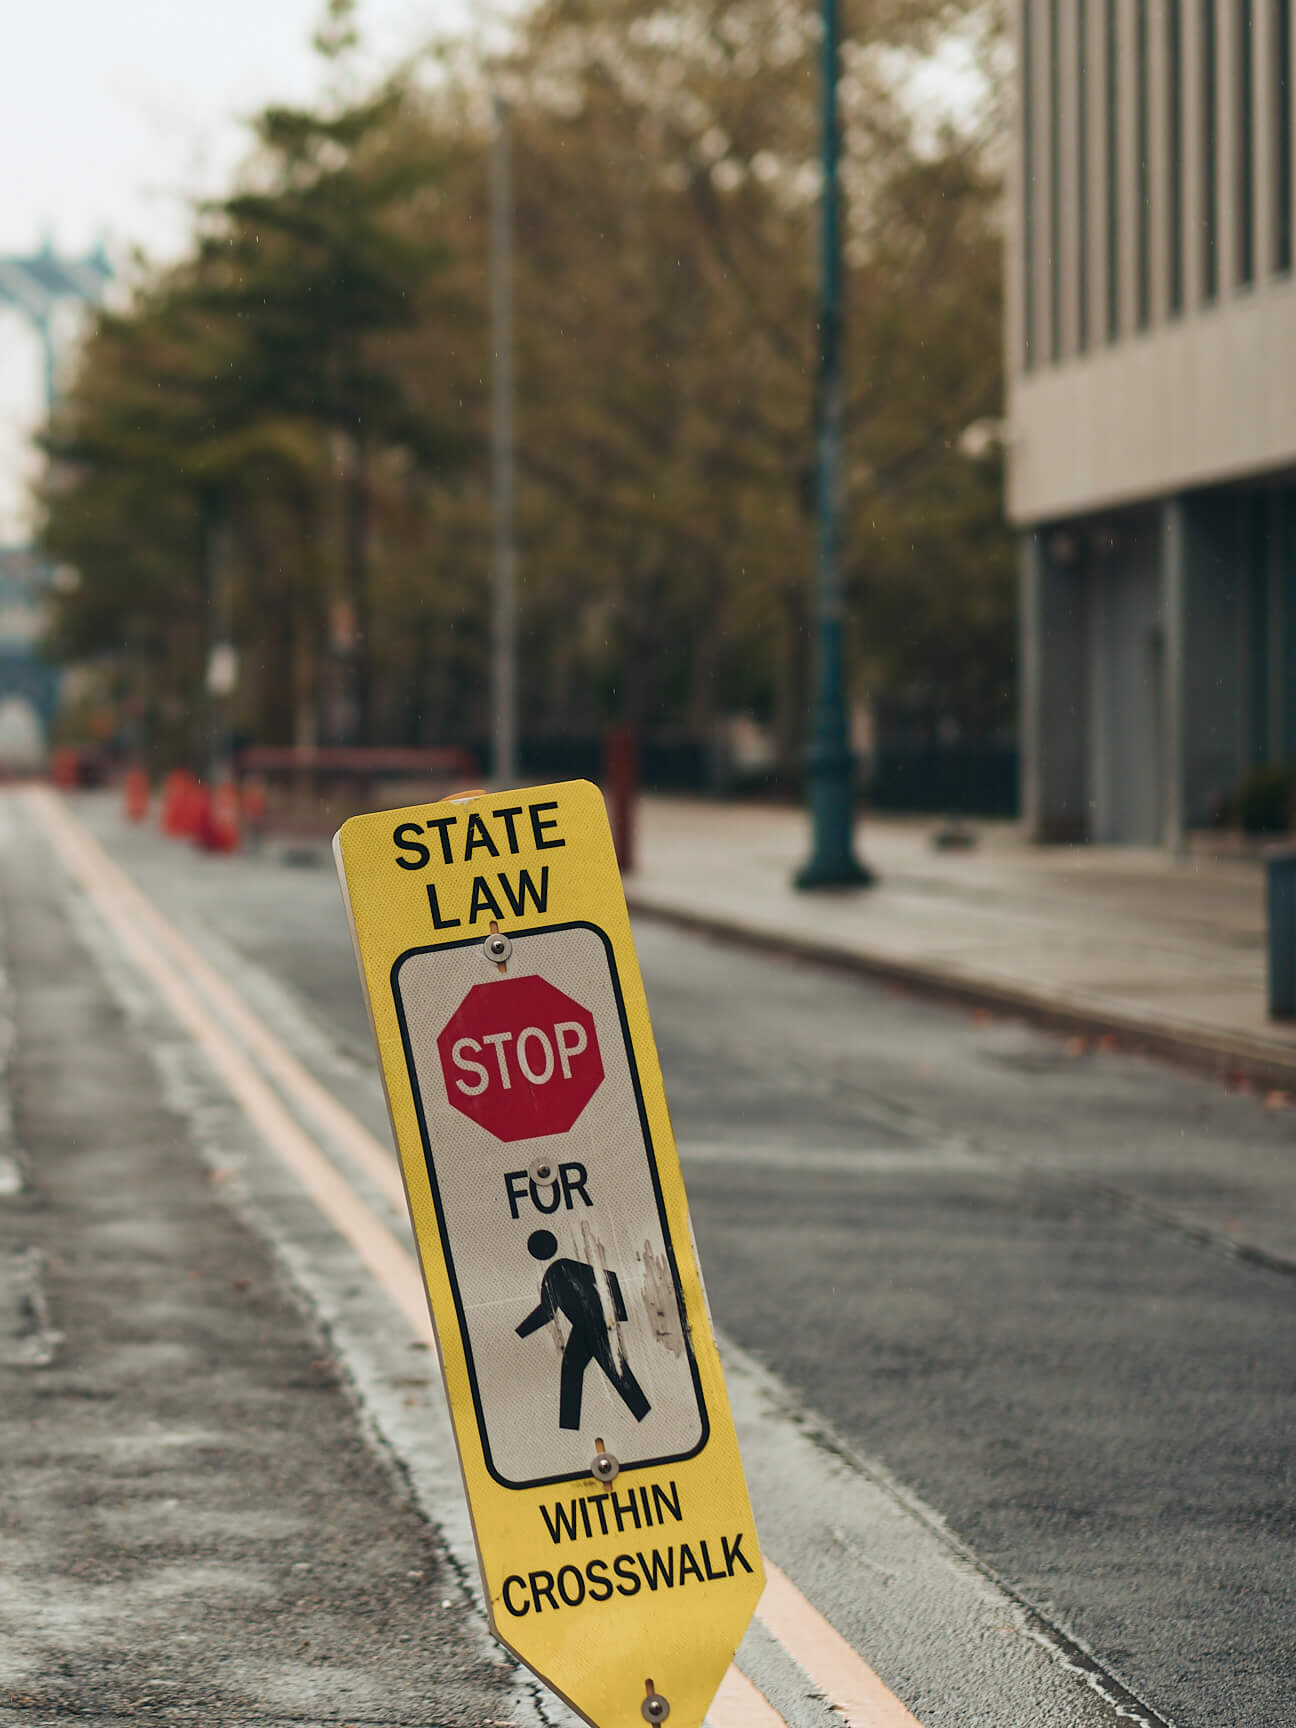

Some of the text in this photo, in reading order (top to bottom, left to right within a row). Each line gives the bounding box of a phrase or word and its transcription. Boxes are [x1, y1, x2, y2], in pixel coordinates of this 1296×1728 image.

[392, 801, 566, 871] STATE
[426, 866, 549, 930] LAW
[451, 1021, 588, 1096] STOP
[504, 1162, 593, 1219] FOR
[539, 1481, 683, 1544] WITHIN
[502, 1533, 754, 1617] CROSSWALK
